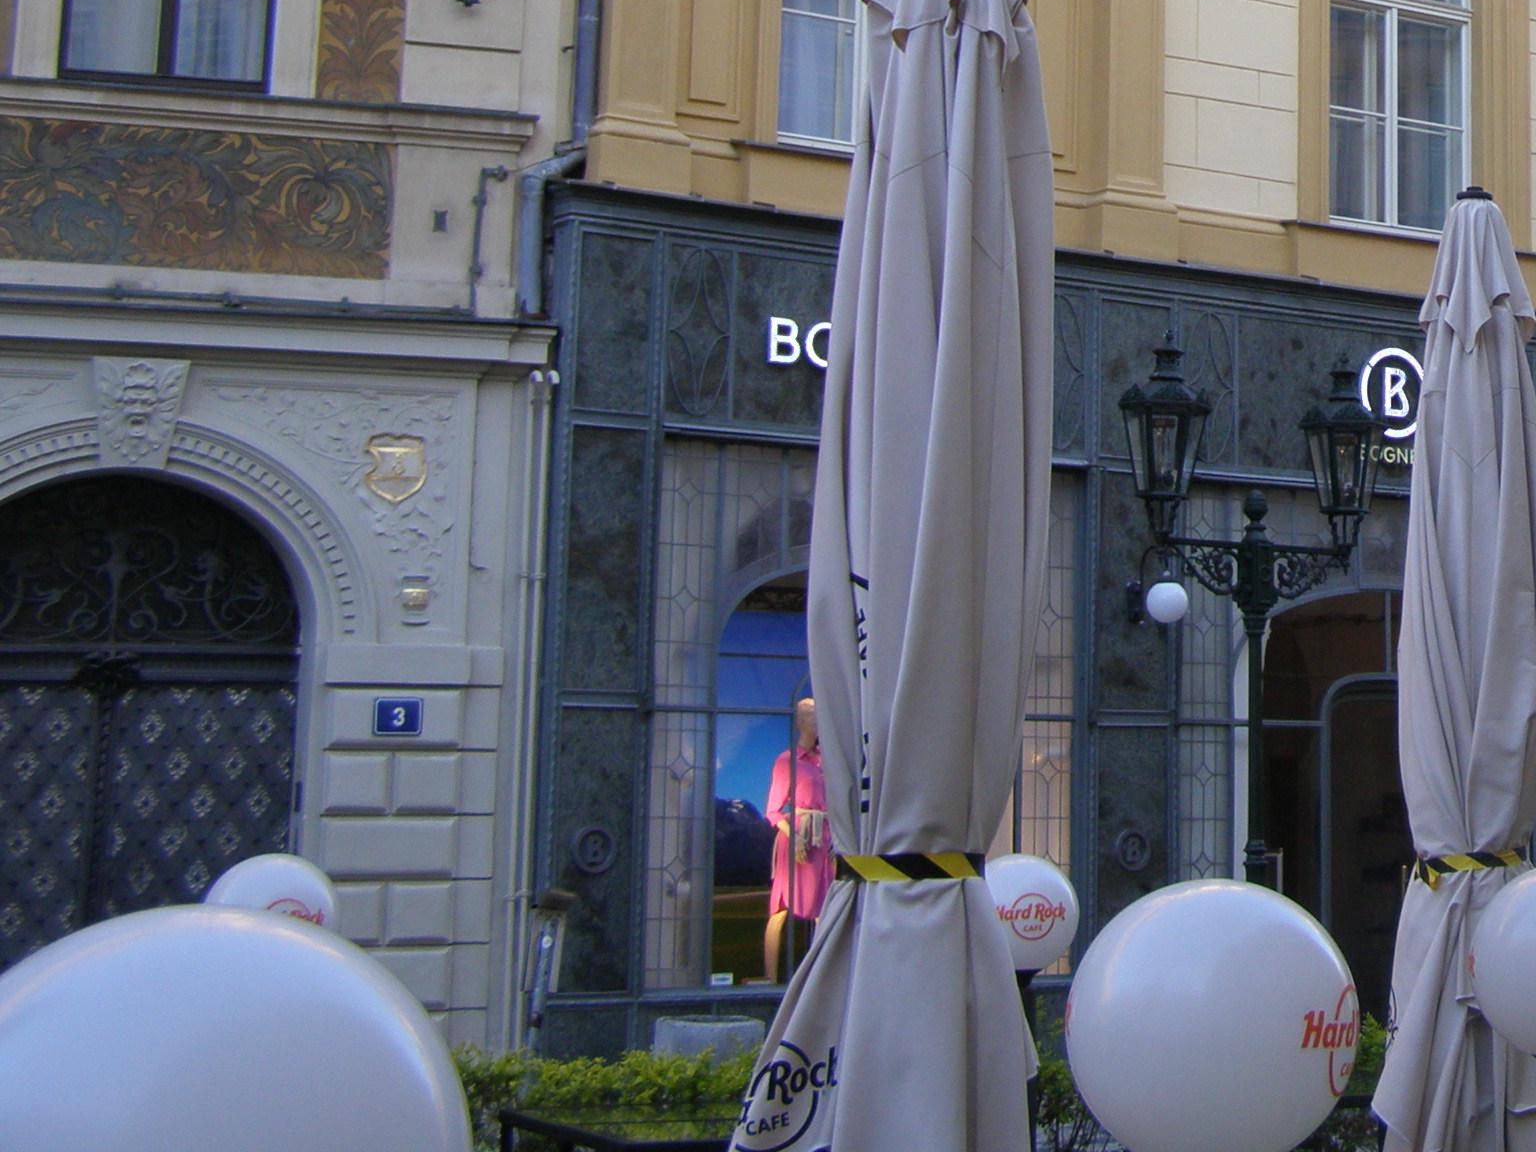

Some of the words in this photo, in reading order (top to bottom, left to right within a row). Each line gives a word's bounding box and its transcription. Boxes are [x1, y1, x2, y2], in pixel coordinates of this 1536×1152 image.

[393, 707, 406, 727] 3
[1035, 900, 1067, 923] Rock
[1023, 924, 1044, 932] CAFE
[1301, 1008, 1356, 1049] Hard
[745, 1111, 791, 1137] CAFE
